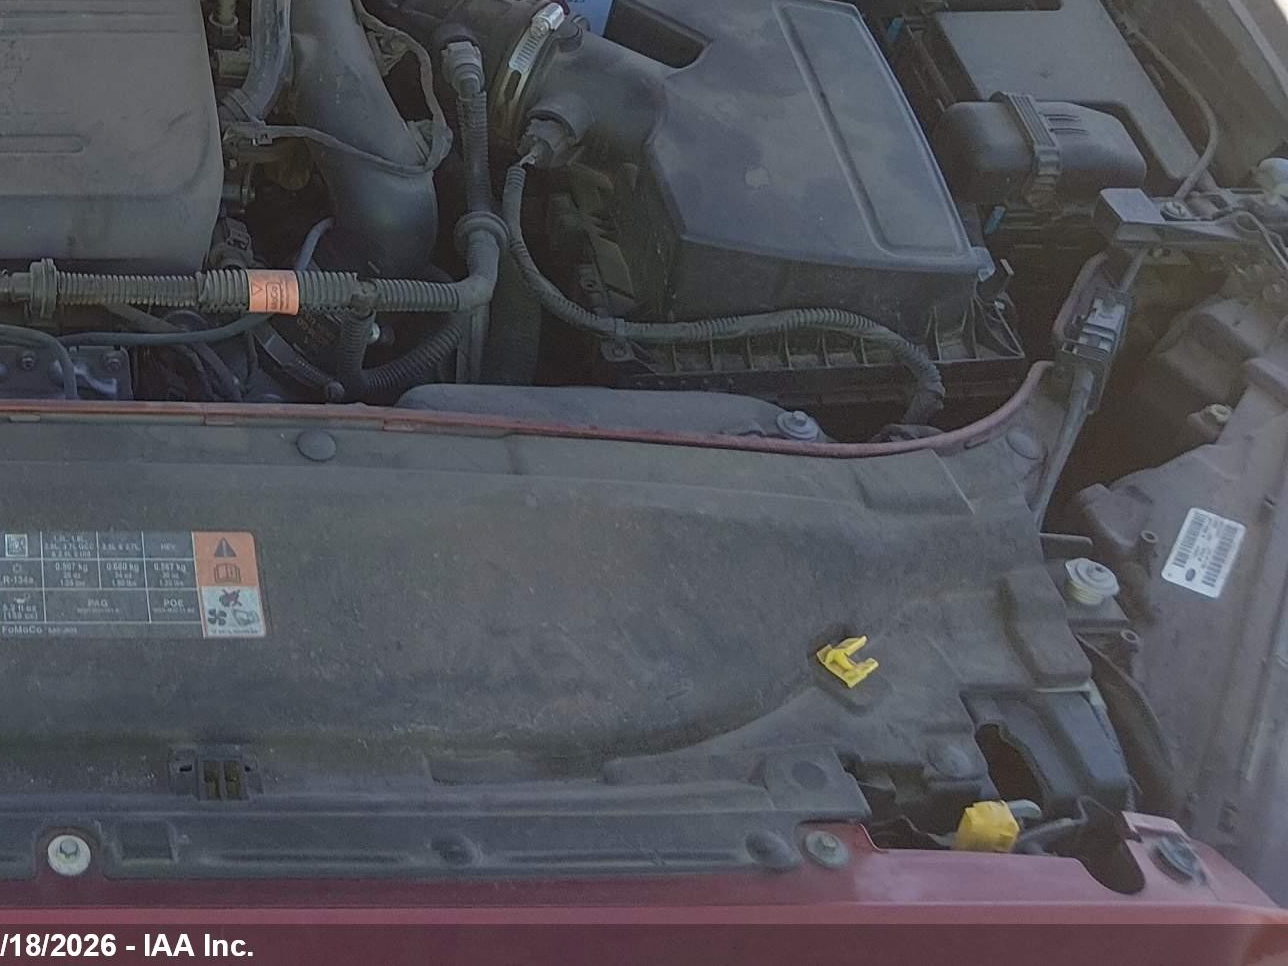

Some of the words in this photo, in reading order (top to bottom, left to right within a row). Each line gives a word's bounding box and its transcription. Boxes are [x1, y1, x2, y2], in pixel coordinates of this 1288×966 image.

[3, 575, 35, 586] R-134a
[87, 597, 109, 607] PAG
[163, 598, 184, 608] POE
[2, 625, 43, 635] FoMoCo
